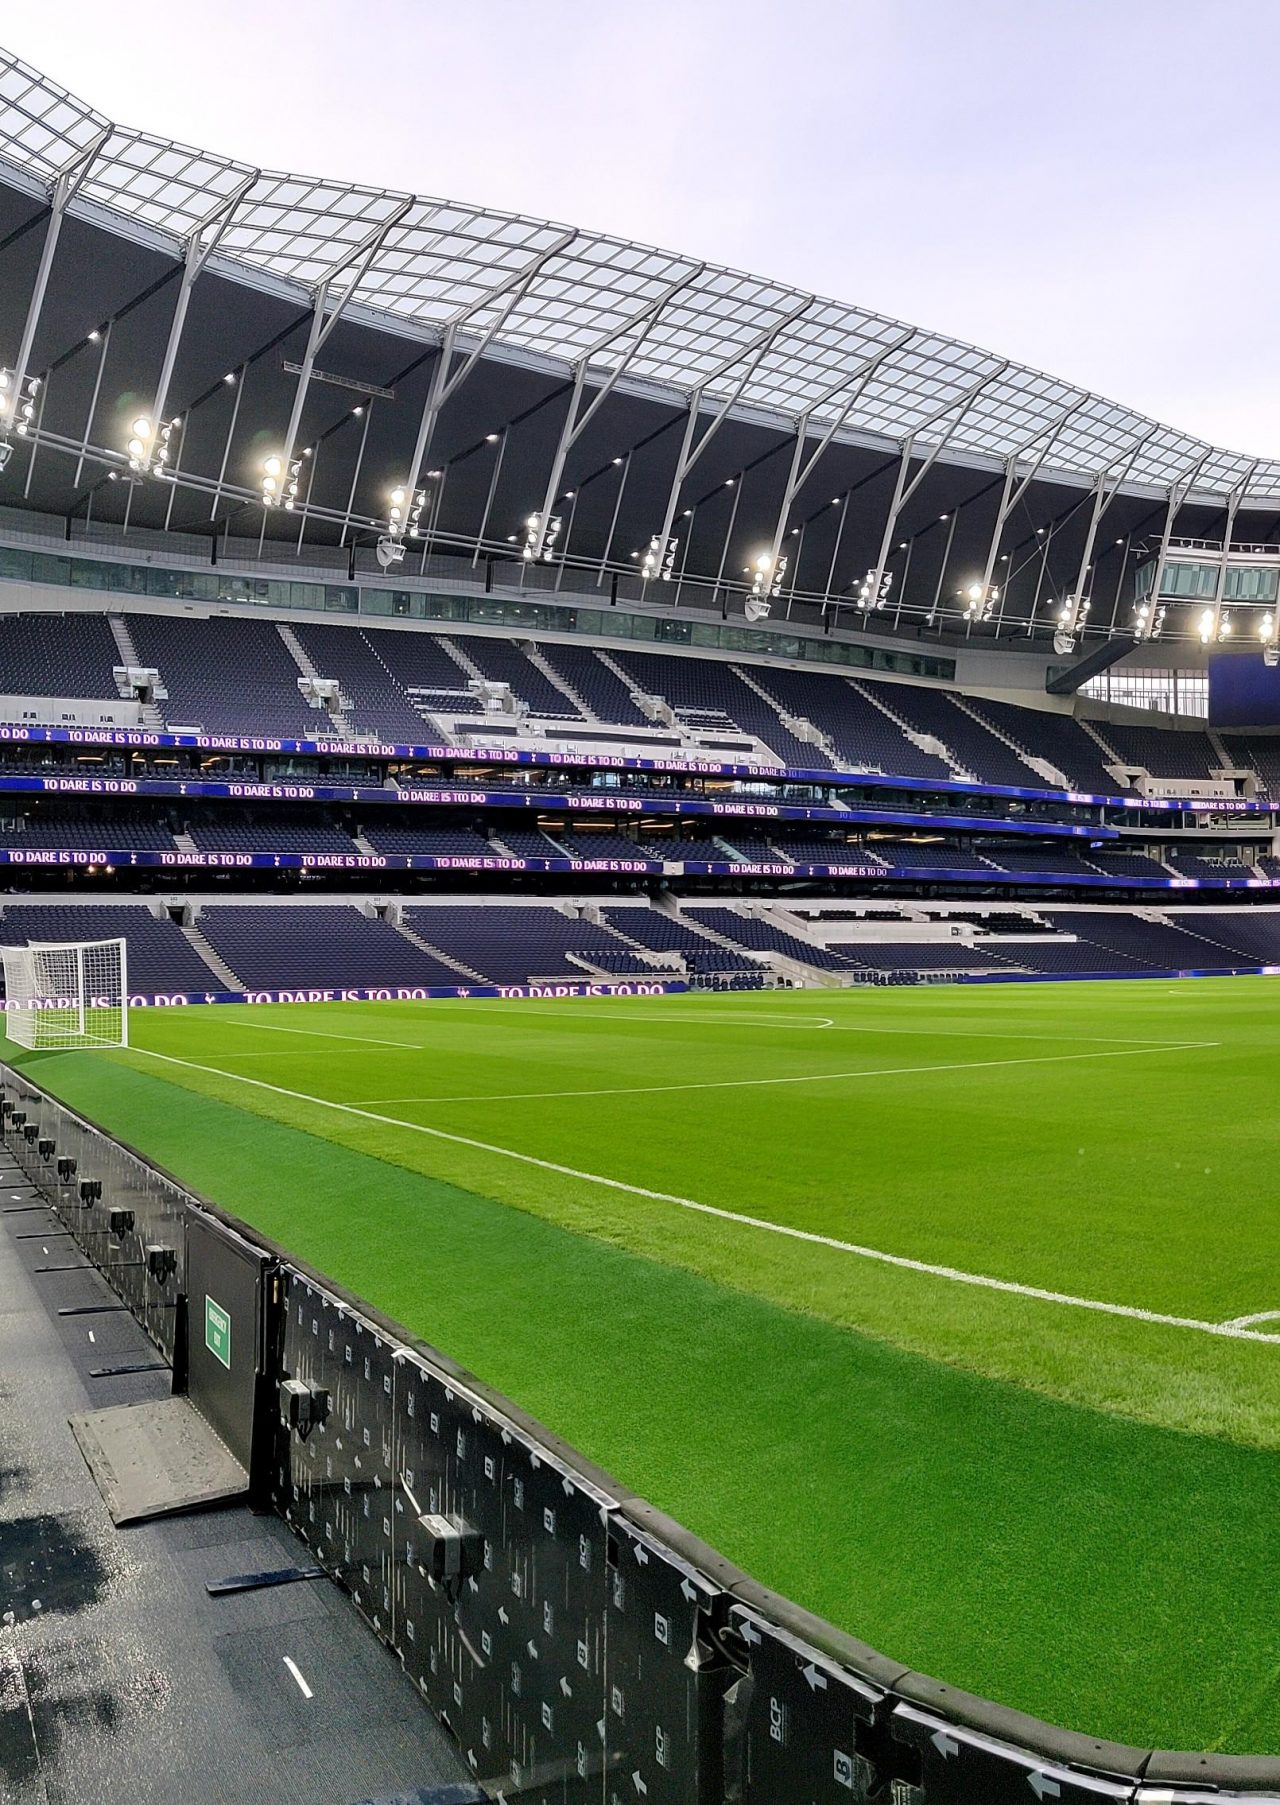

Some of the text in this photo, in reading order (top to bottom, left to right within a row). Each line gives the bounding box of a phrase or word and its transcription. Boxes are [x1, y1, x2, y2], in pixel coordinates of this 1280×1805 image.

[0, 728, 28, 740] O DO
[68, 731, 158, 744] TO DARE IS TO DO
[196, 736, 282, 750] TO DARE IS TO DO
[316, 742, 395, 755] TO DARE IS TO DO
[549, 754, 624, 766] TO DARE IS TO DO
[654, 760, 721, 774] TO DARE IS TO DO
[748, 766, 758, 775] TO
[760, 768, 778, 776] DARE
[43, 779, 136, 792] TO DARE IS TO DO
[228, 785, 314, 798] TO DARE IS TO DO
[568, 798, 642, 810] TO DARE IS TO DO
[713, 804, 778, 816] TO DARE IS TO DO
[8, 852, 106, 863] TO DARE IS TO DO
[160, 854, 252, 865] TO DARE IS TO DO
[302, 856, 386, 866] TO DARE IS TO DO
[570, 861, 647, 872] TO DARE IS TO DO
[729, 864, 795, 876] TO DARE IS TO DO
[828, 866, 887, 877] TO DARE IS TO DO
[243, 989, 426, 1004] TO DARE IS TO DO
[497, 985, 663, 998] TO DARE IS TO DO
[91, 996, 110, 1008] IS
[154, 994, 187, 1006] DO
[770, 1697, 782, 1742] BCP
[656, 1725, 664, 1767] BCP
